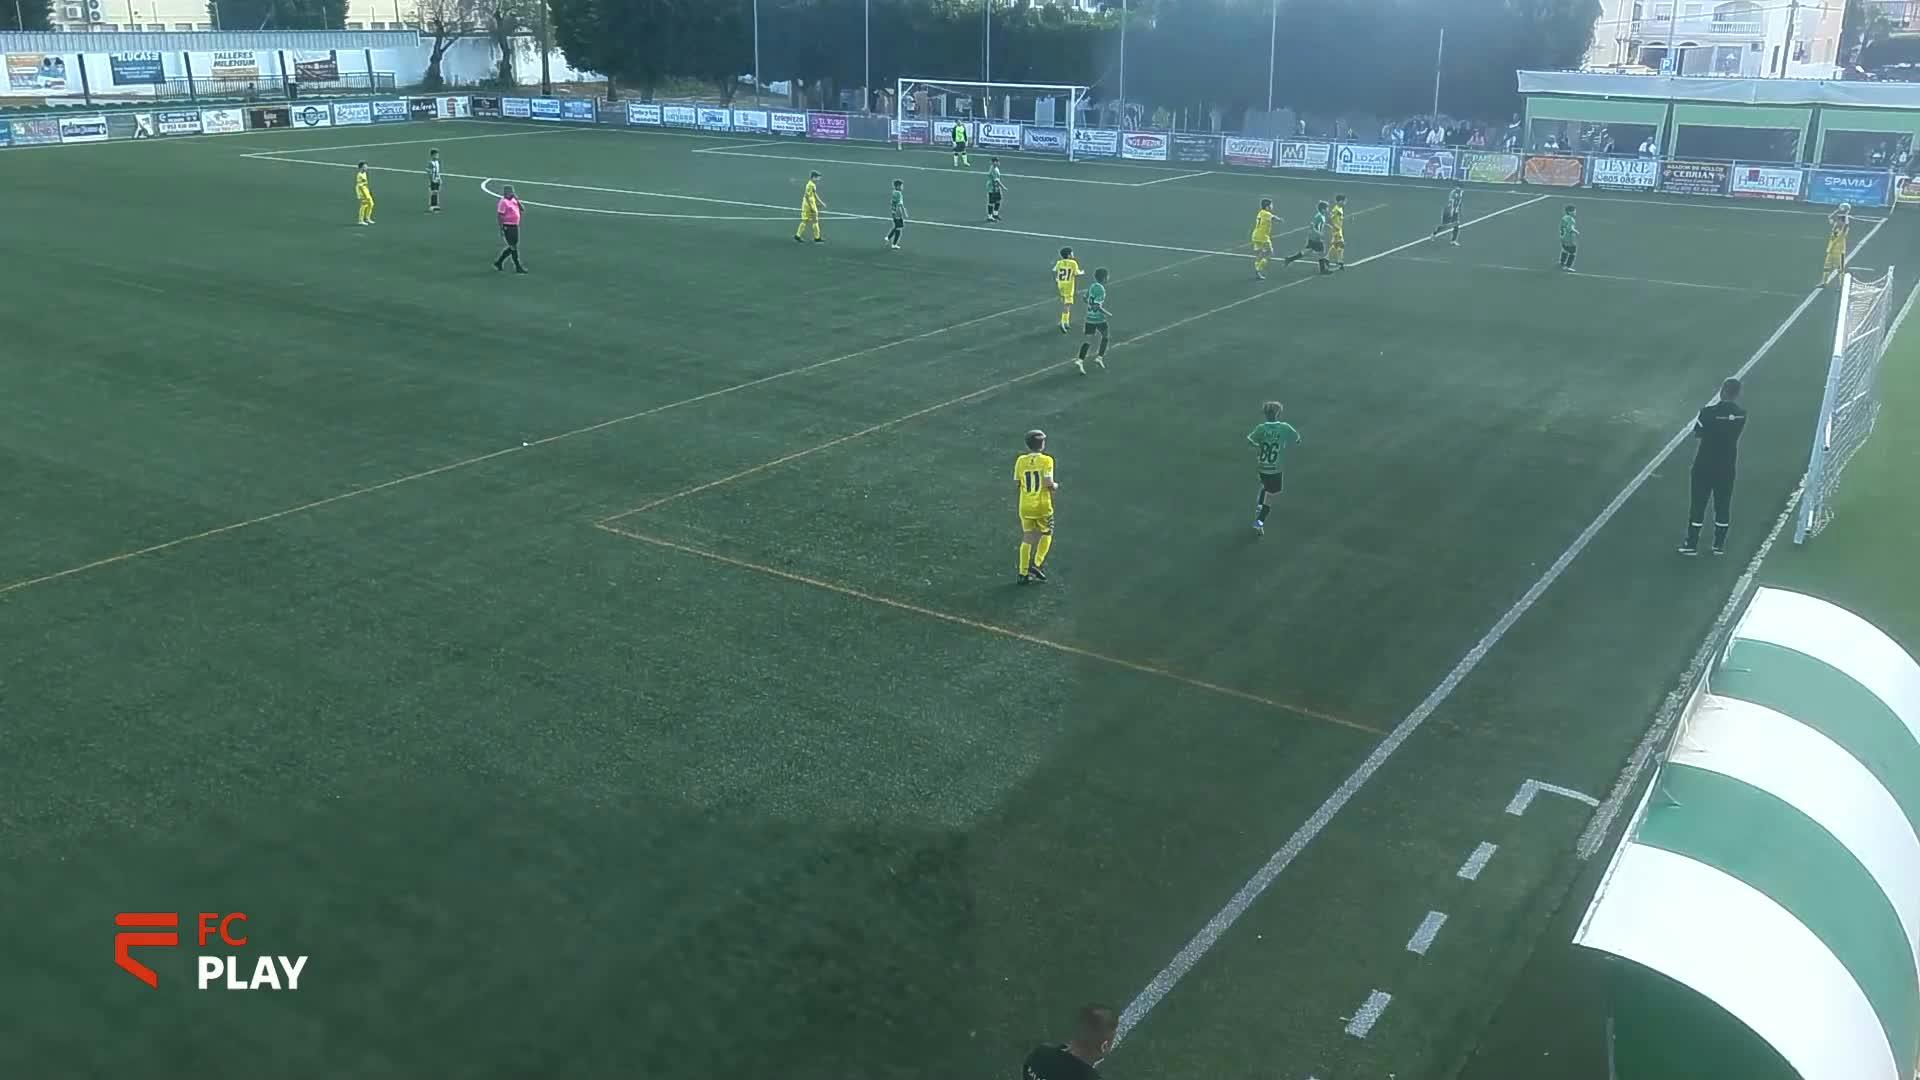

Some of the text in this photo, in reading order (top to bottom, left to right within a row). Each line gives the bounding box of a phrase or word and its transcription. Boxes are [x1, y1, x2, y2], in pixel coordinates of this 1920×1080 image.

[213, 51, 254, 60] TALLERES
[1599, 160, 1650, 174] JEYRE
[1738, 173, 1796, 188] HBITAR
[1058, 268, 1072, 281] 21
[1024, 470, 1041, 493] 11
